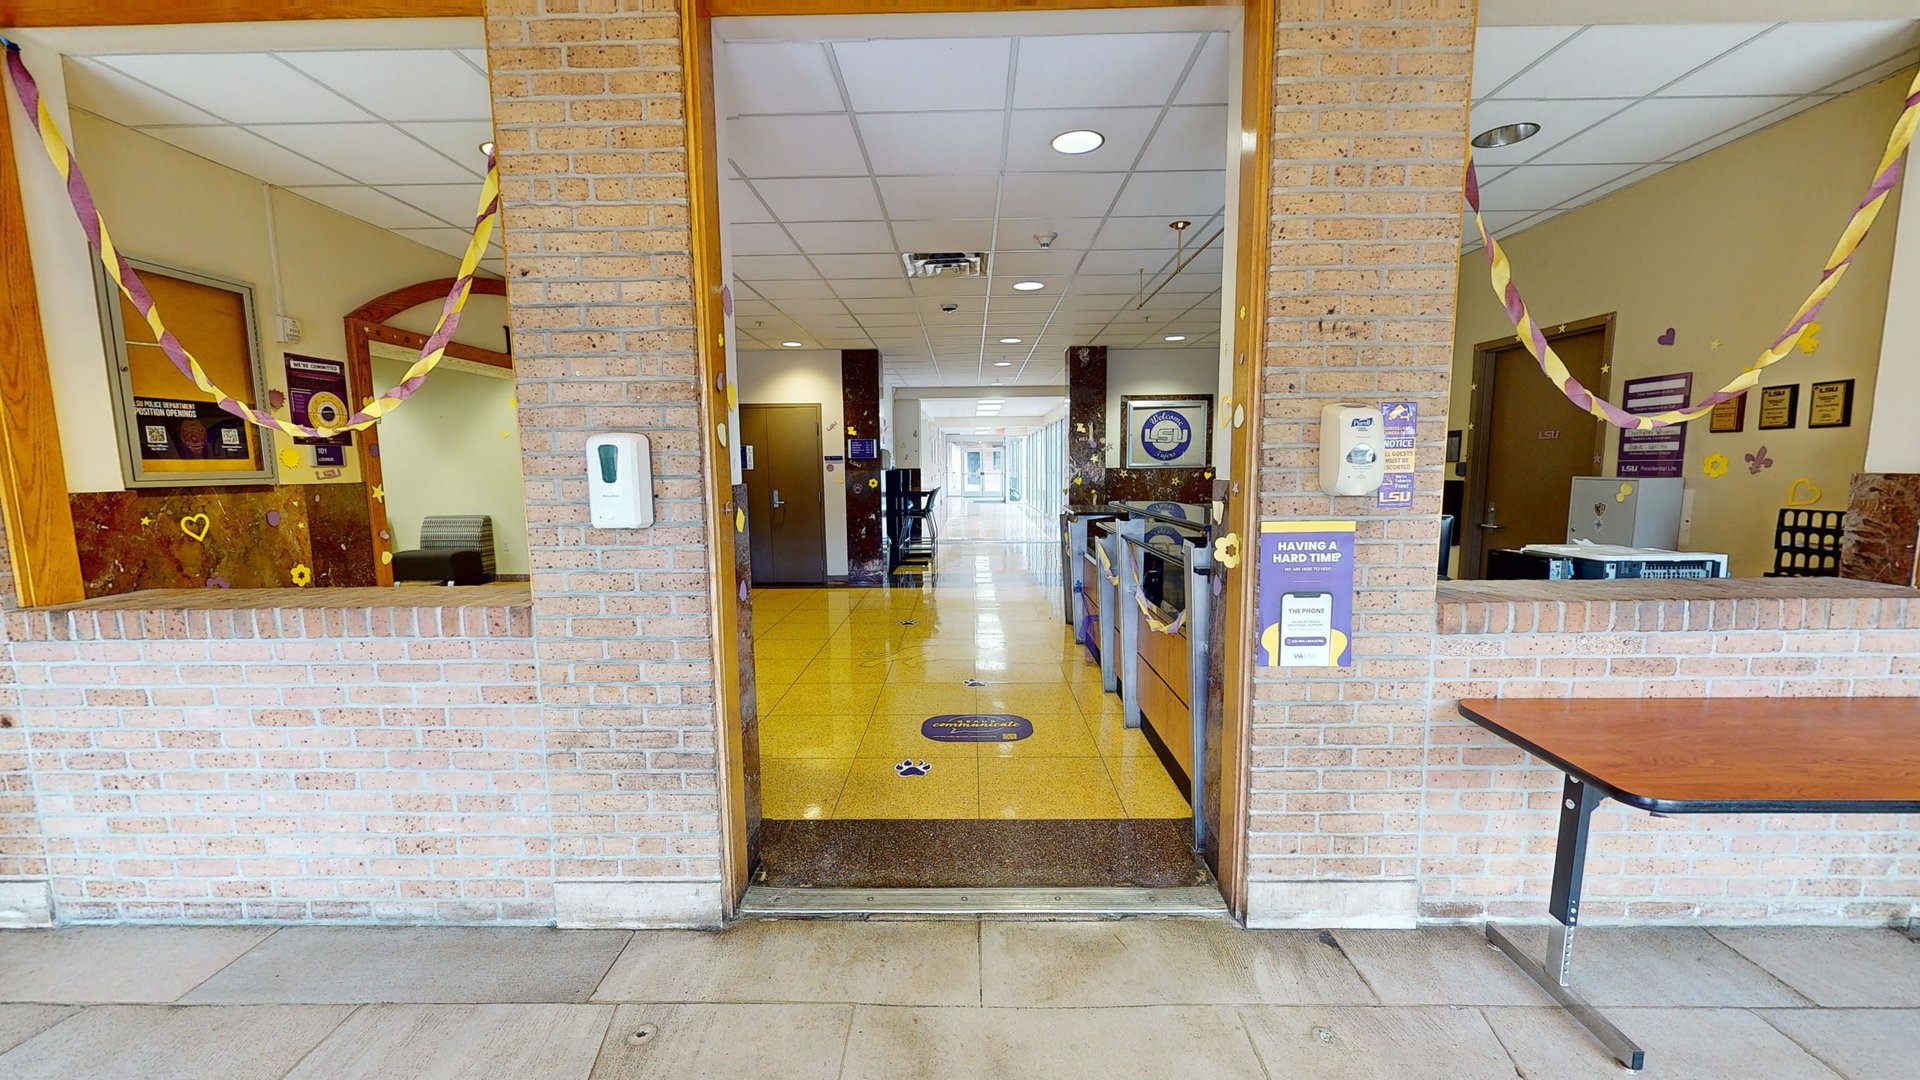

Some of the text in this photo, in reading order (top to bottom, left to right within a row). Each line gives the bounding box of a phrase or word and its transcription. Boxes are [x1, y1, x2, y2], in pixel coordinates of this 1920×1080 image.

[310, 363, 338, 371] COMMITTED
[144, 400, 162, 408] POLICE
[162, 401, 195, 410] DEPARTMENT
[135, 408, 197, 418] POSITION OPENINGS
[1149, 412, 1184, 425] Welcome
[1144, 428, 1189, 443] LSU
[1538, 430, 1560, 439] LSU
[1384, 439, 1413, 448] NOTICE
[1379, 491, 1411, 503] LSU
[1277, 541, 1337, 551] HAVING A
[1272, 553, 1307, 563] HARD
[932, 720, 1022, 728] communicate
